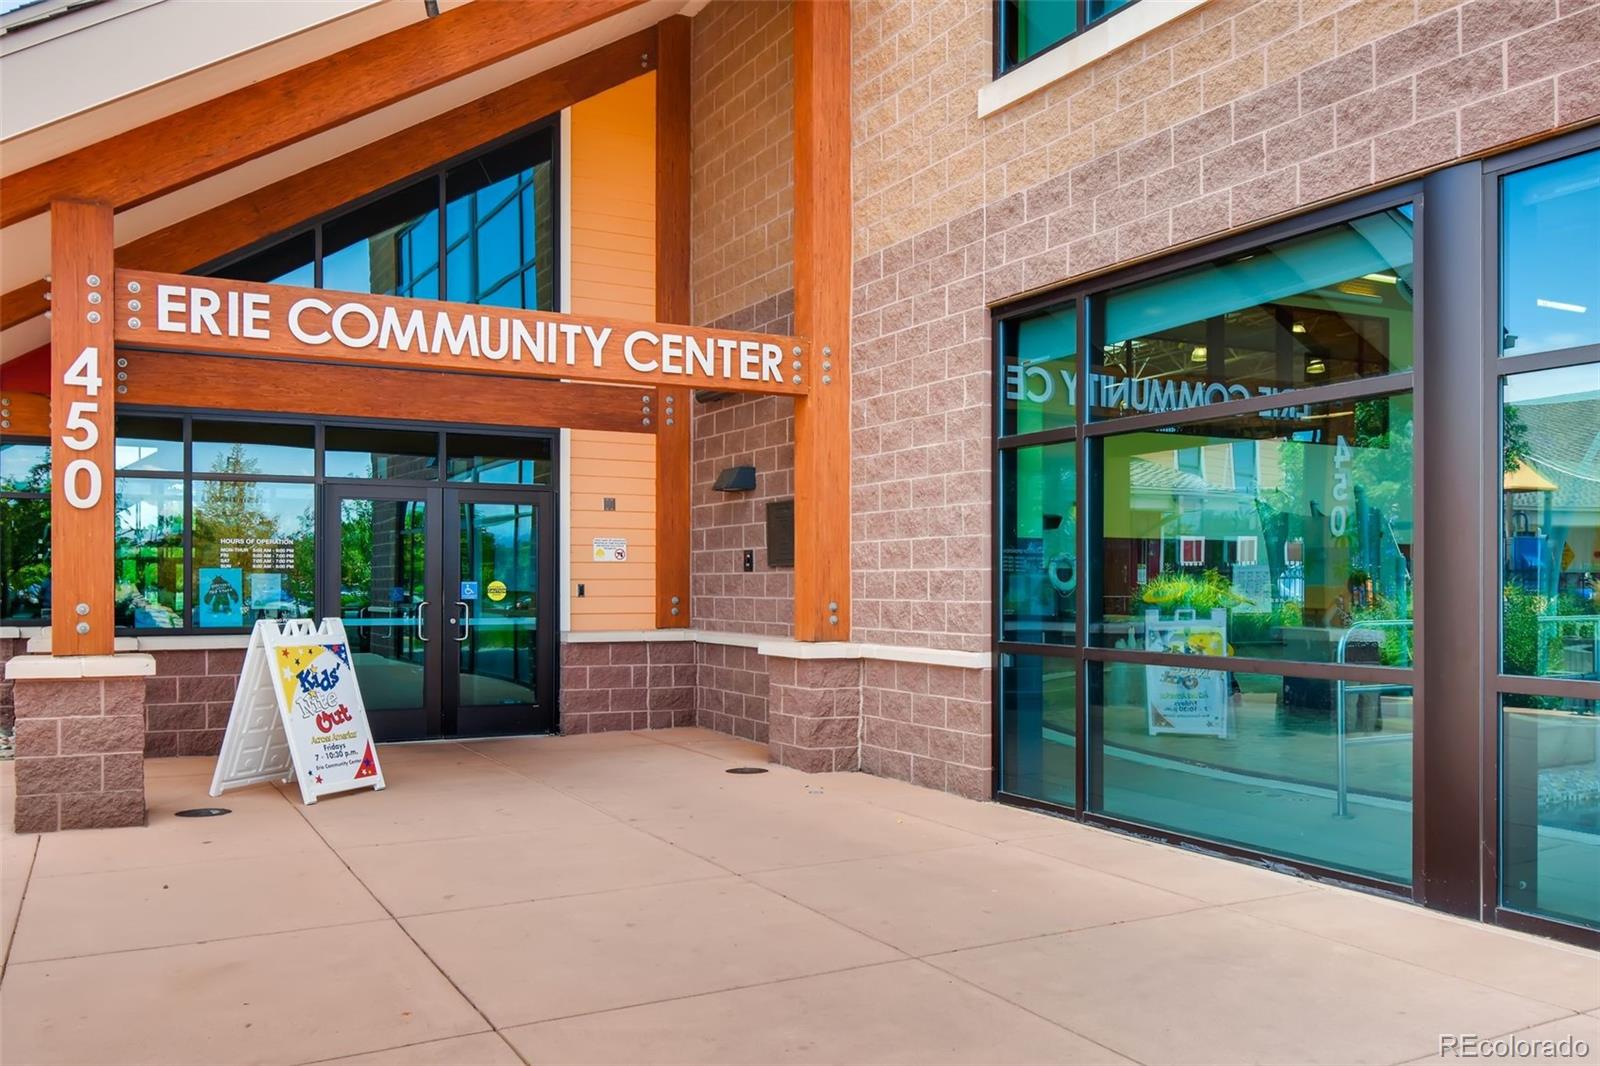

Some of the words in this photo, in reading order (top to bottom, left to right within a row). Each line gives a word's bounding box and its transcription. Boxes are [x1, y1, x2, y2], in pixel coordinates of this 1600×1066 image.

[157, 284, 270, 339] ERIE
[288, 298, 613, 367] COMMUNITY
[623, 330, 784, 383] CENTER
[61, 346, 103, 509] 450
[295, 691, 338, 720] Nite
[315, 704, 352, 734] Out
[315, 753, 320, 761] 7
[325, 750, 344, 760] 10:30
[344, 750, 359, 759] p.m.
[323, 743, 346, 751] Fridays
